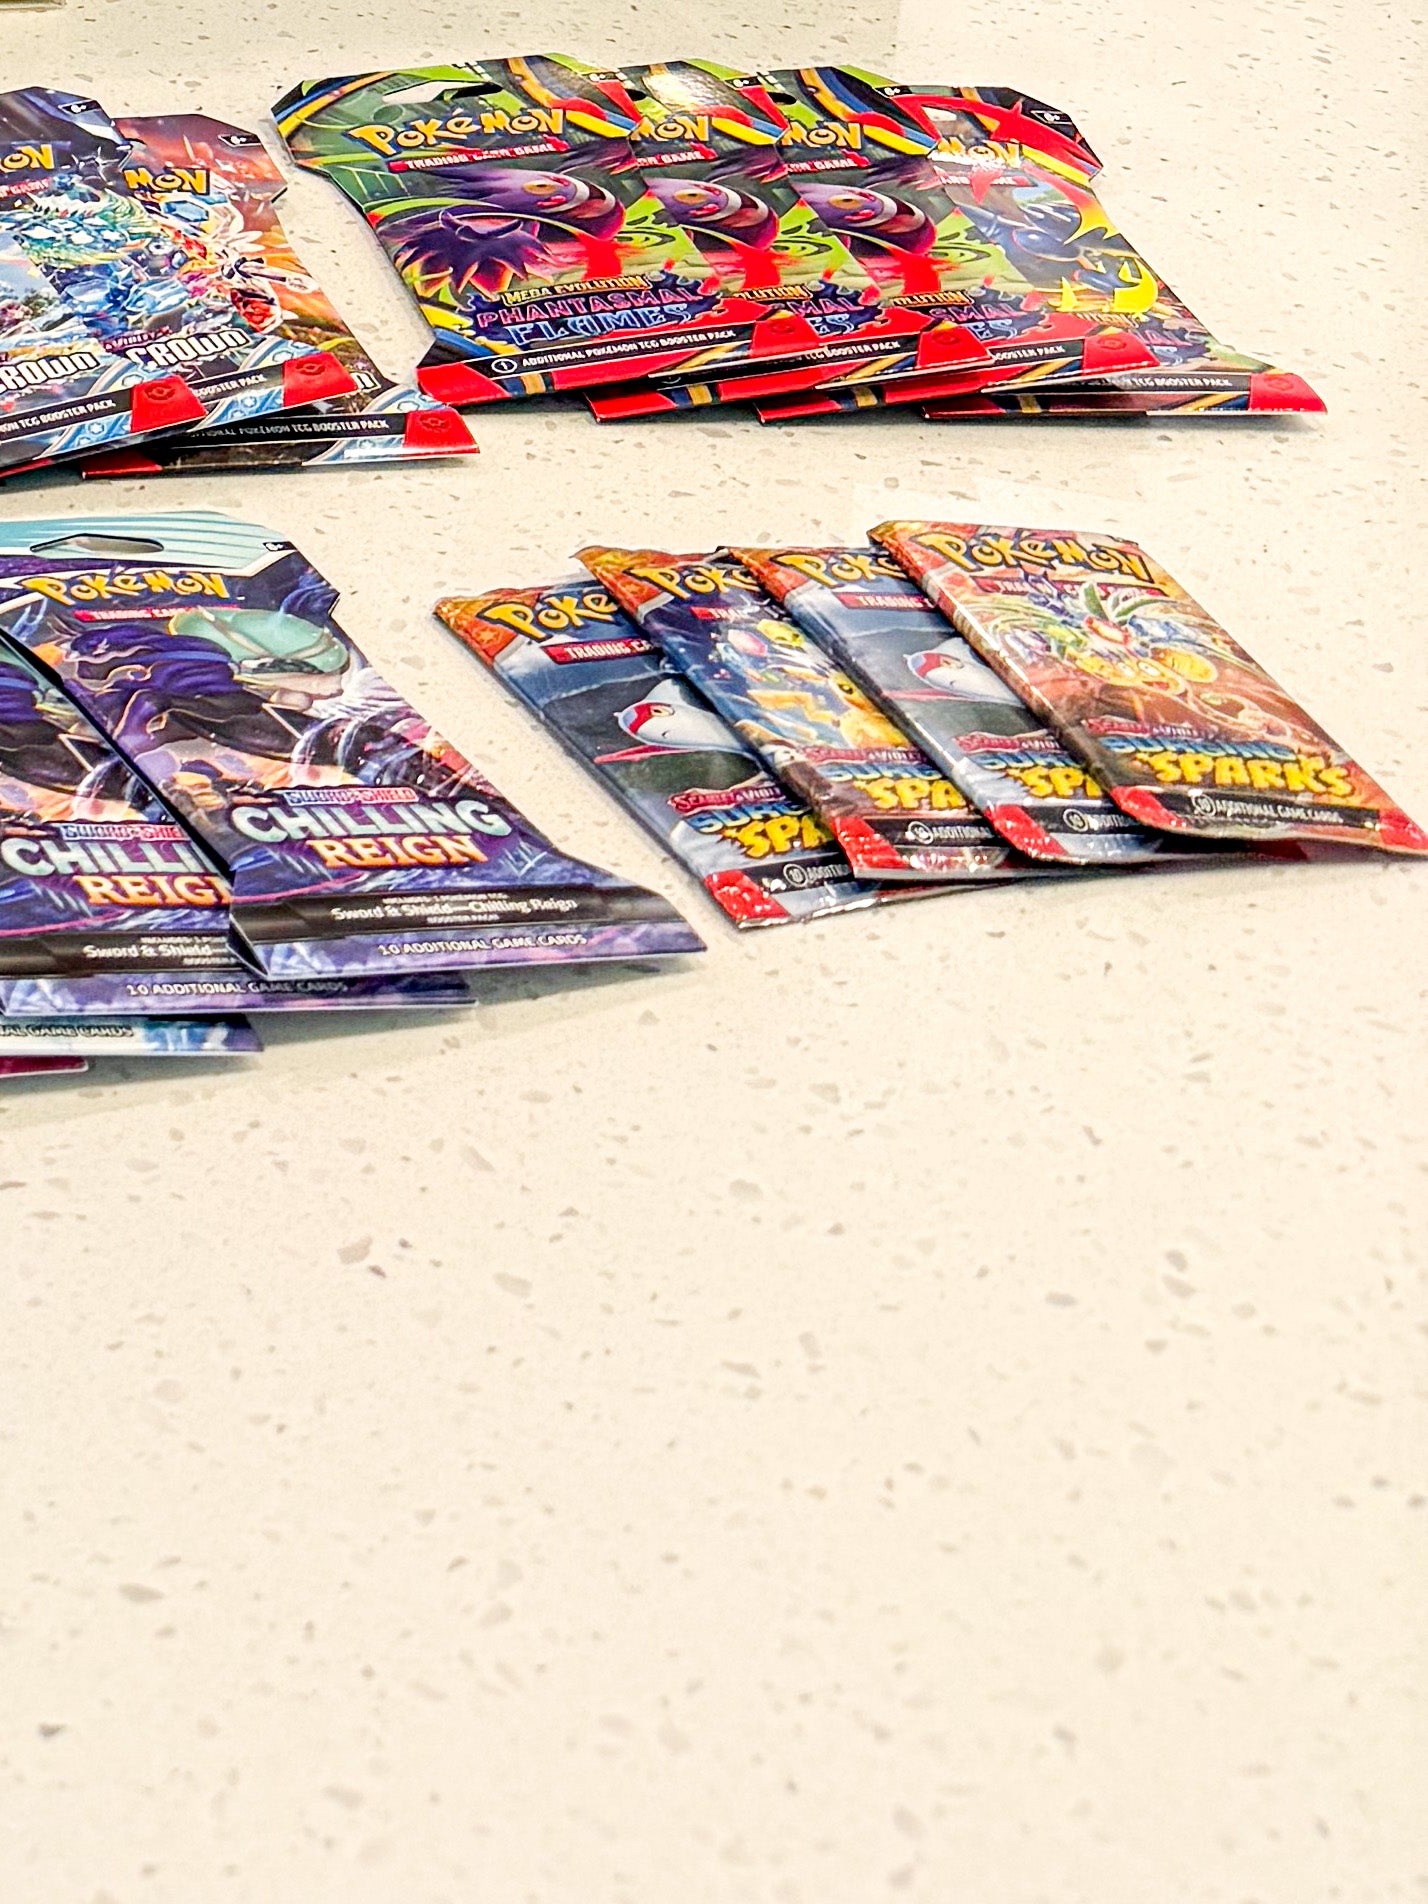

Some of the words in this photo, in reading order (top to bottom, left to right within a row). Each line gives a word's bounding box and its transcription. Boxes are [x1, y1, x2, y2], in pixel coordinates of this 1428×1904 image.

[406, 152, 470, 170] TRADING
[515, 141, 557, 157] GAME
[476, 288, 701, 326] PHANTASMAL
[505, 287, 552, 306] MEGA
[507, 304, 692, 347] FLAMES
[522, 349, 587, 368] ADDITIONAL
[660, 334, 708, 350] BOOSTER
[708, 327, 737, 341] PACK
[563, 641, 631, 662] TRADING
[1134, 751, 1354, 797] SPARKS
[231, 799, 514, 844] CHILLING
[305, 835, 489, 869] REIGN
